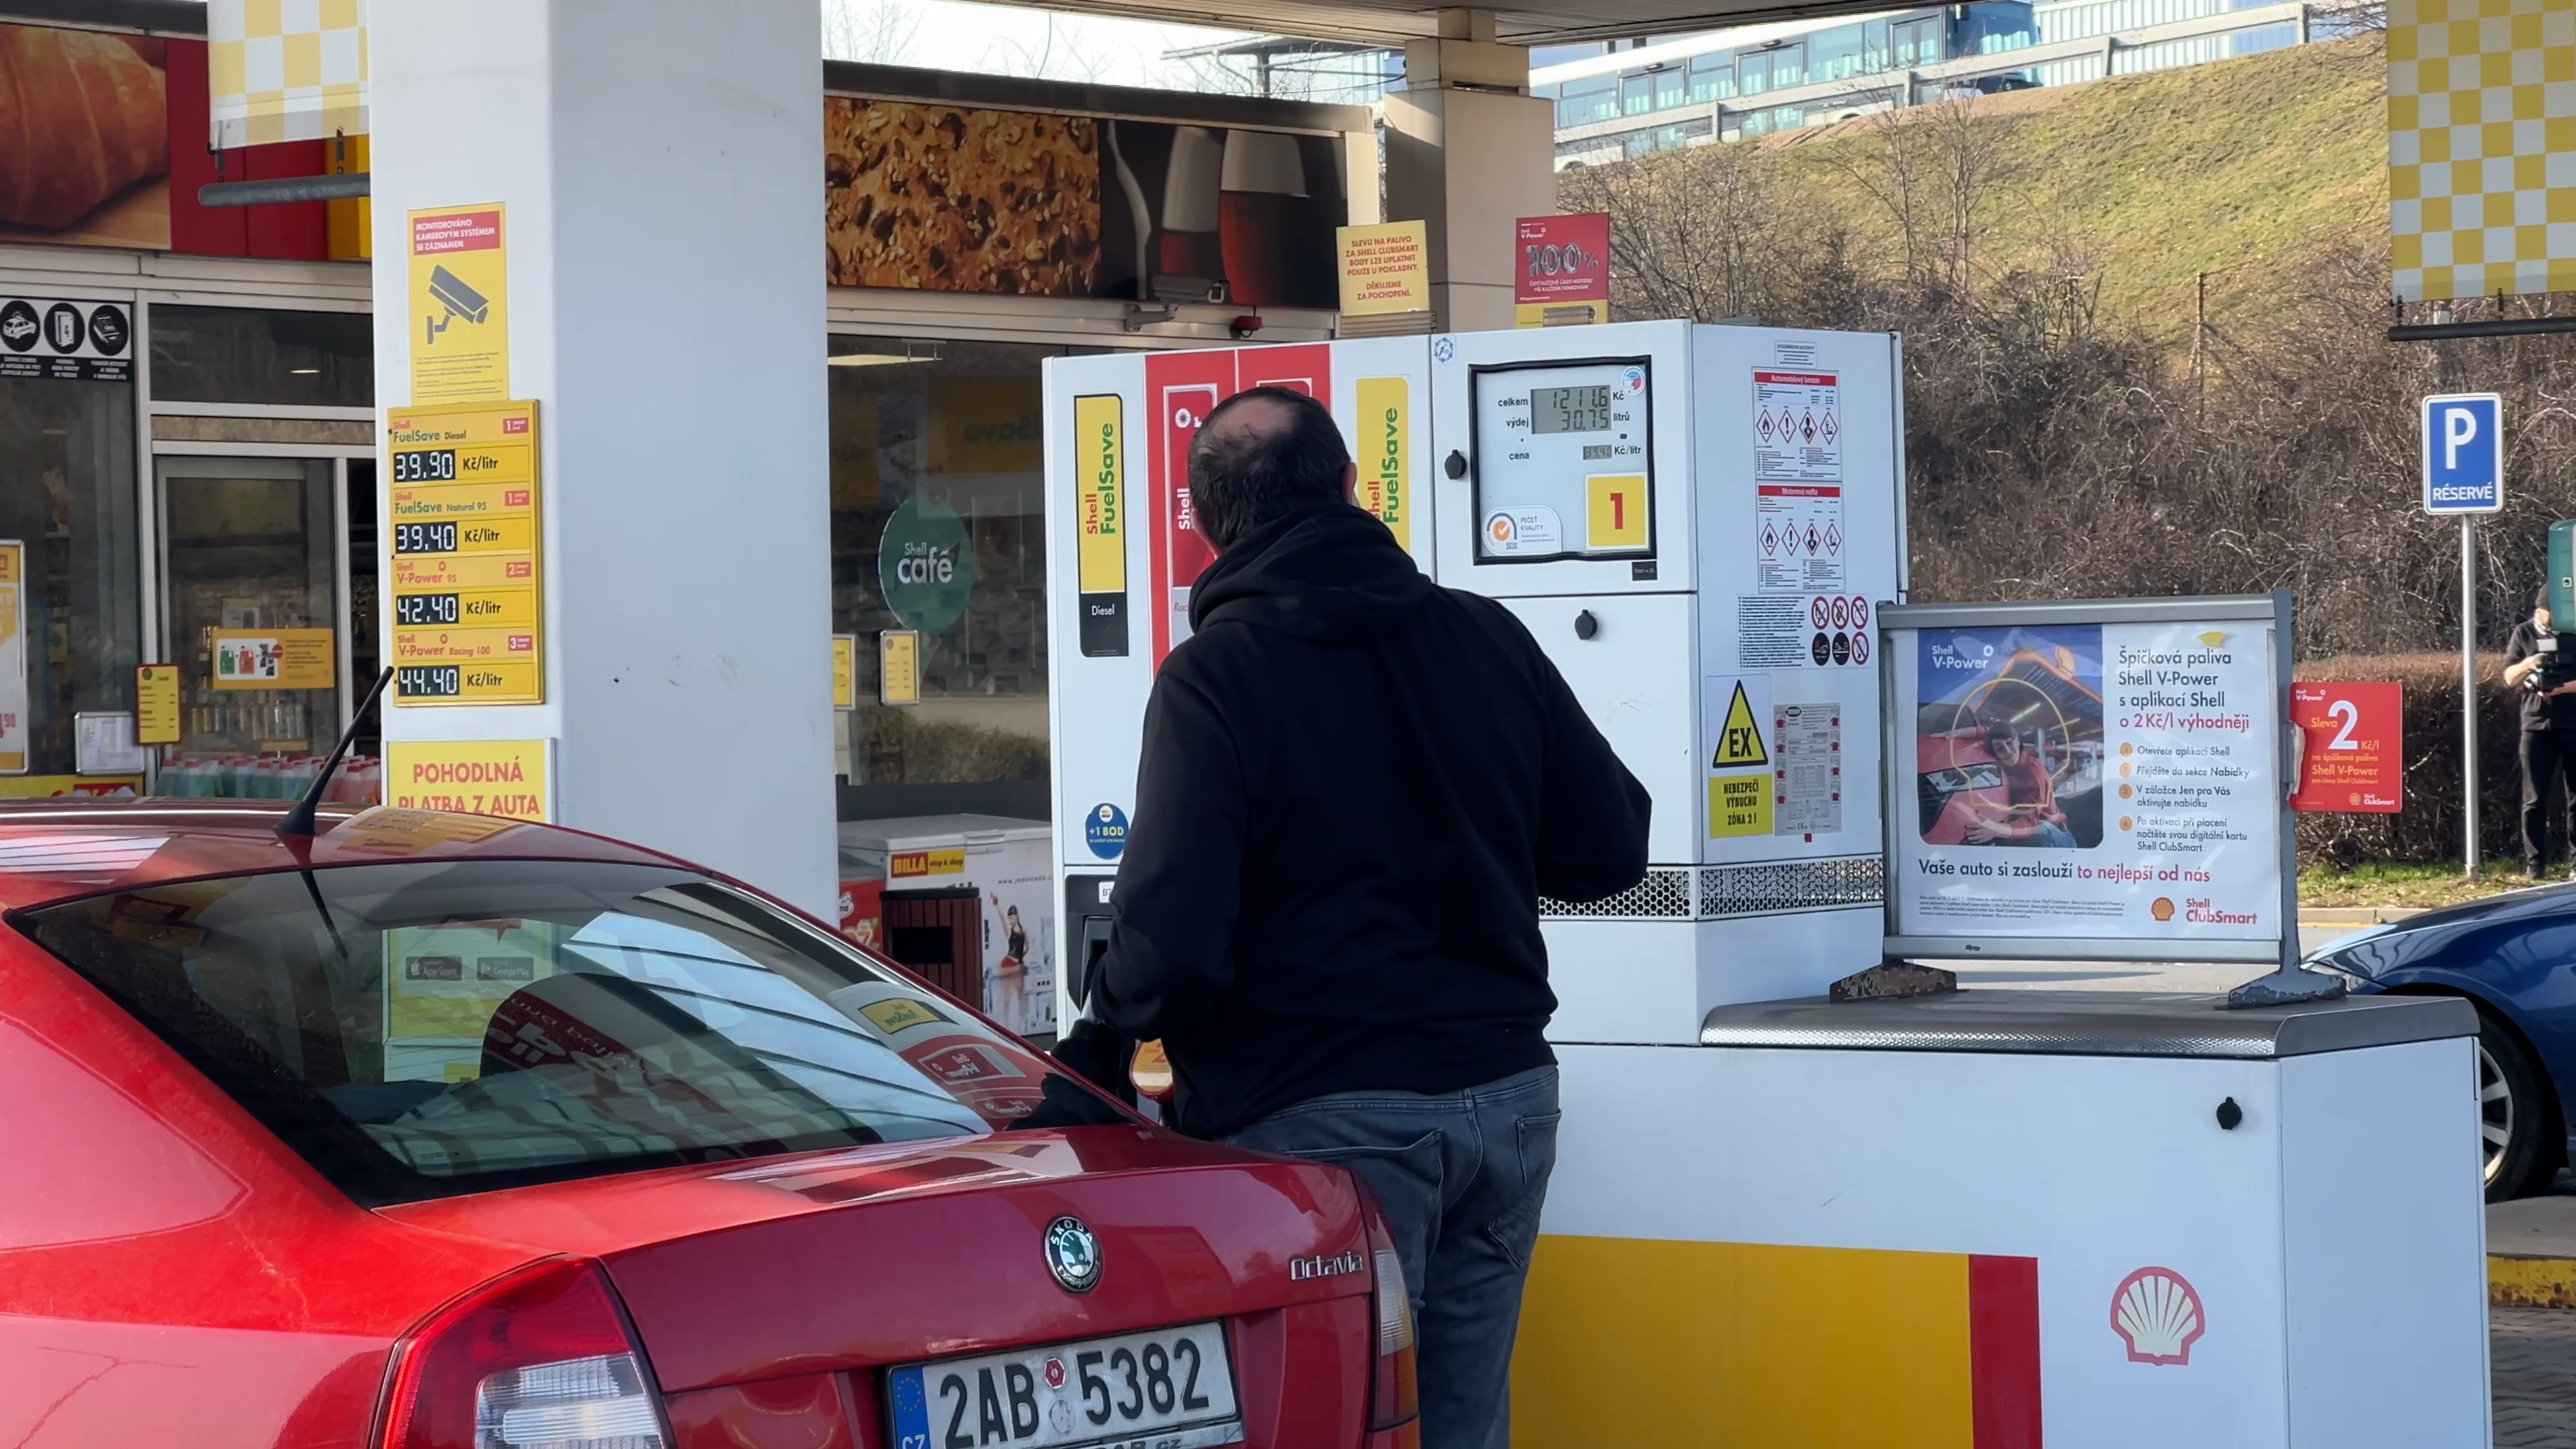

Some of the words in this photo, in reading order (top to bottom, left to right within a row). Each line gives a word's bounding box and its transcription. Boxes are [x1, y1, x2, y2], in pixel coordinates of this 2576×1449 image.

[416, 218, 472, 231] MONITOROVÁNO
[416, 229, 459, 241] KAMEROVÝM
[460, 227, 495, 237] SYSTÉMEM
[1352, 239, 1373, 247] SLEVU
[1387, 235, 1411, 244] PALIVO
[425, 240, 465, 251] ZÁZNAMEM
[1379, 245, 1418, 254] CLUBSMART
[1383, 254, 1415, 263] UPLATNIT
[1347, 268, 1370, 276] POUZE
[1379, 264, 1419, 273] POKLADNY.
[1366, 281, 1401, 290] DĚKUJEME
[1368, 288, 1411, 299] POCHOPENÍ.
[1498, 397, 1528, 407] celkem
[1613, 391, 1624, 400] Kč
[393, 421, 410, 429] Shell
[507, 420, 511, 431] 1
[1506, 417, 1529, 428] výdej
[1613, 412, 1630, 422] litrů
[394, 430, 440, 442] FuelSave
[445, 431, 466, 439] Diesel
[2445, 408, 2477, 470] P
[1509, 451, 1529, 460] cena
[1615, 445, 1642, 455] Kč/litr
[396, 451, 453, 480] 39,90
[463, 455, 498, 470] Kč/litr
[1381, 407, 1399, 523] FuelSave
[1097, 423, 1116, 535] FuelSave
[508, 493, 513, 503] 1
[2433, 482, 2493, 500] RÉSERVÉ
[395, 501, 442, 514] FuelSave
[1085, 494, 1097, 535] Shell
[1177, 488, 1191, 531] Shell
[1610, 492, 1623, 529] 1
[398, 525, 455, 550] 39,40
[464, 528, 500, 543] Kč/litr
[904, 542, 927, 556] Shell
[396, 562, 413, 570] Shell
[508, 564, 515, 575] 2
[898, 546, 953, 584] café
[397, 573, 443, 584] V-Power
[447, 574, 456, 582] 95
[398, 596, 456, 623] 42,40
[466, 600, 501, 615] Kč/litr
[1091, 604, 1115, 616] Diesel
[398, 635, 415, 643] Shell
[510, 637, 516, 649] 3
[398, 645, 444, 656] V-Power
[449, 648, 474, 657] Racing
[477, 646, 490, 655] 100
[1932, 645, 1953, 655] Shell
[2119, 645, 2182, 668] Špičková
[2188, 648, 2231, 669] paliva
[1932, 656, 1988, 669] V-Power
[400, 669, 457, 694] 44,40
[467, 672, 502, 687] Kč/litr
[2118, 669, 2152, 686] Shell
[2157, 671, 2218, 686] V-Power
[2119, 696, 2126, 706] s
[2131, 691, 2186, 710] aplikací
[2190, 691, 2224, 707] Shell
[2119, 717, 2129, 728] o
[2134, 713, 2143, 727] 2
[2146, 712, 2174, 731] Kč/l
[2178, 712, 2249, 733] výhodněji
[2310, 717, 2338, 728] Sleva
[2328, 700, 2358, 749] 2
[2361, 740, 2379, 751] Kč/l
[1729, 728, 1752, 757] EX
[2137, 746, 2173, 755] Otevřete
[2210, 747, 2230, 756] Shell
[2323, 753, 2355, 763] špičková
[413, 755, 524, 784] POHODLNÁ
[2137, 766, 2169, 777] Přejděte
[2172, 767, 2183, 775] do
[2185, 767, 2208, 776] sekce
[2210, 767, 2250, 778] Nabídky
[2312, 764, 2335, 775] Shell
[2337, 765, 2379, 776] V-Power
[1724, 779, 1758, 794] NEBEZPEČÍ
[2136, 785, 2143, 794] V
[2145, 784, 2177, 794] záložce
[2179, 786, 2194, 796] Jen
[2197, 788, 2212, 797] pro
[2214, 786, 2231, 796] Vás
[472, 795, 484, 814] Z
[490, 794, 540, 815] AUTA
[1726, 795, 1756, 808] VÝBUCHU
[2137, 798, 2171, 809] aktivujte
[2174, 798, 2207, 808] nabídku
[1728, 812, 1746, 826] ZÓNA
[2137, 816, 2147, 825] Po
[2149, 816, 2180, 826] aktivaci
[2183, 817, 2194, 828] při
[2196, 818, 2227, 828] placení
[1089, 826, 1100, 837] +1
[1102, 826, 1124, 837] BOD
[2137, 829, 2167, 839] načtěte
[2169, 831, 2188, 839] svou
[2190, 830, 2224, 842] digitální
[2226, 830, 2248, 841] kartu
[2137, 841, 2157, 851] Shell
[2159, 841, 2203, 852] ClubSmart
[893, 856, 927, 875] BILLA
[1919, 859, 1955, 875] Vaše
[1960, 862, 1993, 876] auto
[1998, 861, 2008, 877] si
[2012, 861, 2073, 878] zaslouží
[2077, 865, 2092, 879] to
[2097, 863, 2153, 884] nejlepší
[2158, 864, 2178, 881] od
[2184, 866, 2210, 882] nás
[2186, 898, 2210, 908] Shell
[2186, 909, 2257, 924] ClubSmart
[494, 967, 516, 978] Google
[1291, 1251, 1363, 1280] Octavia
[939, 1364, 1039, 1449] 2AB
[1075, 1338, 1210, 1426] 5382
